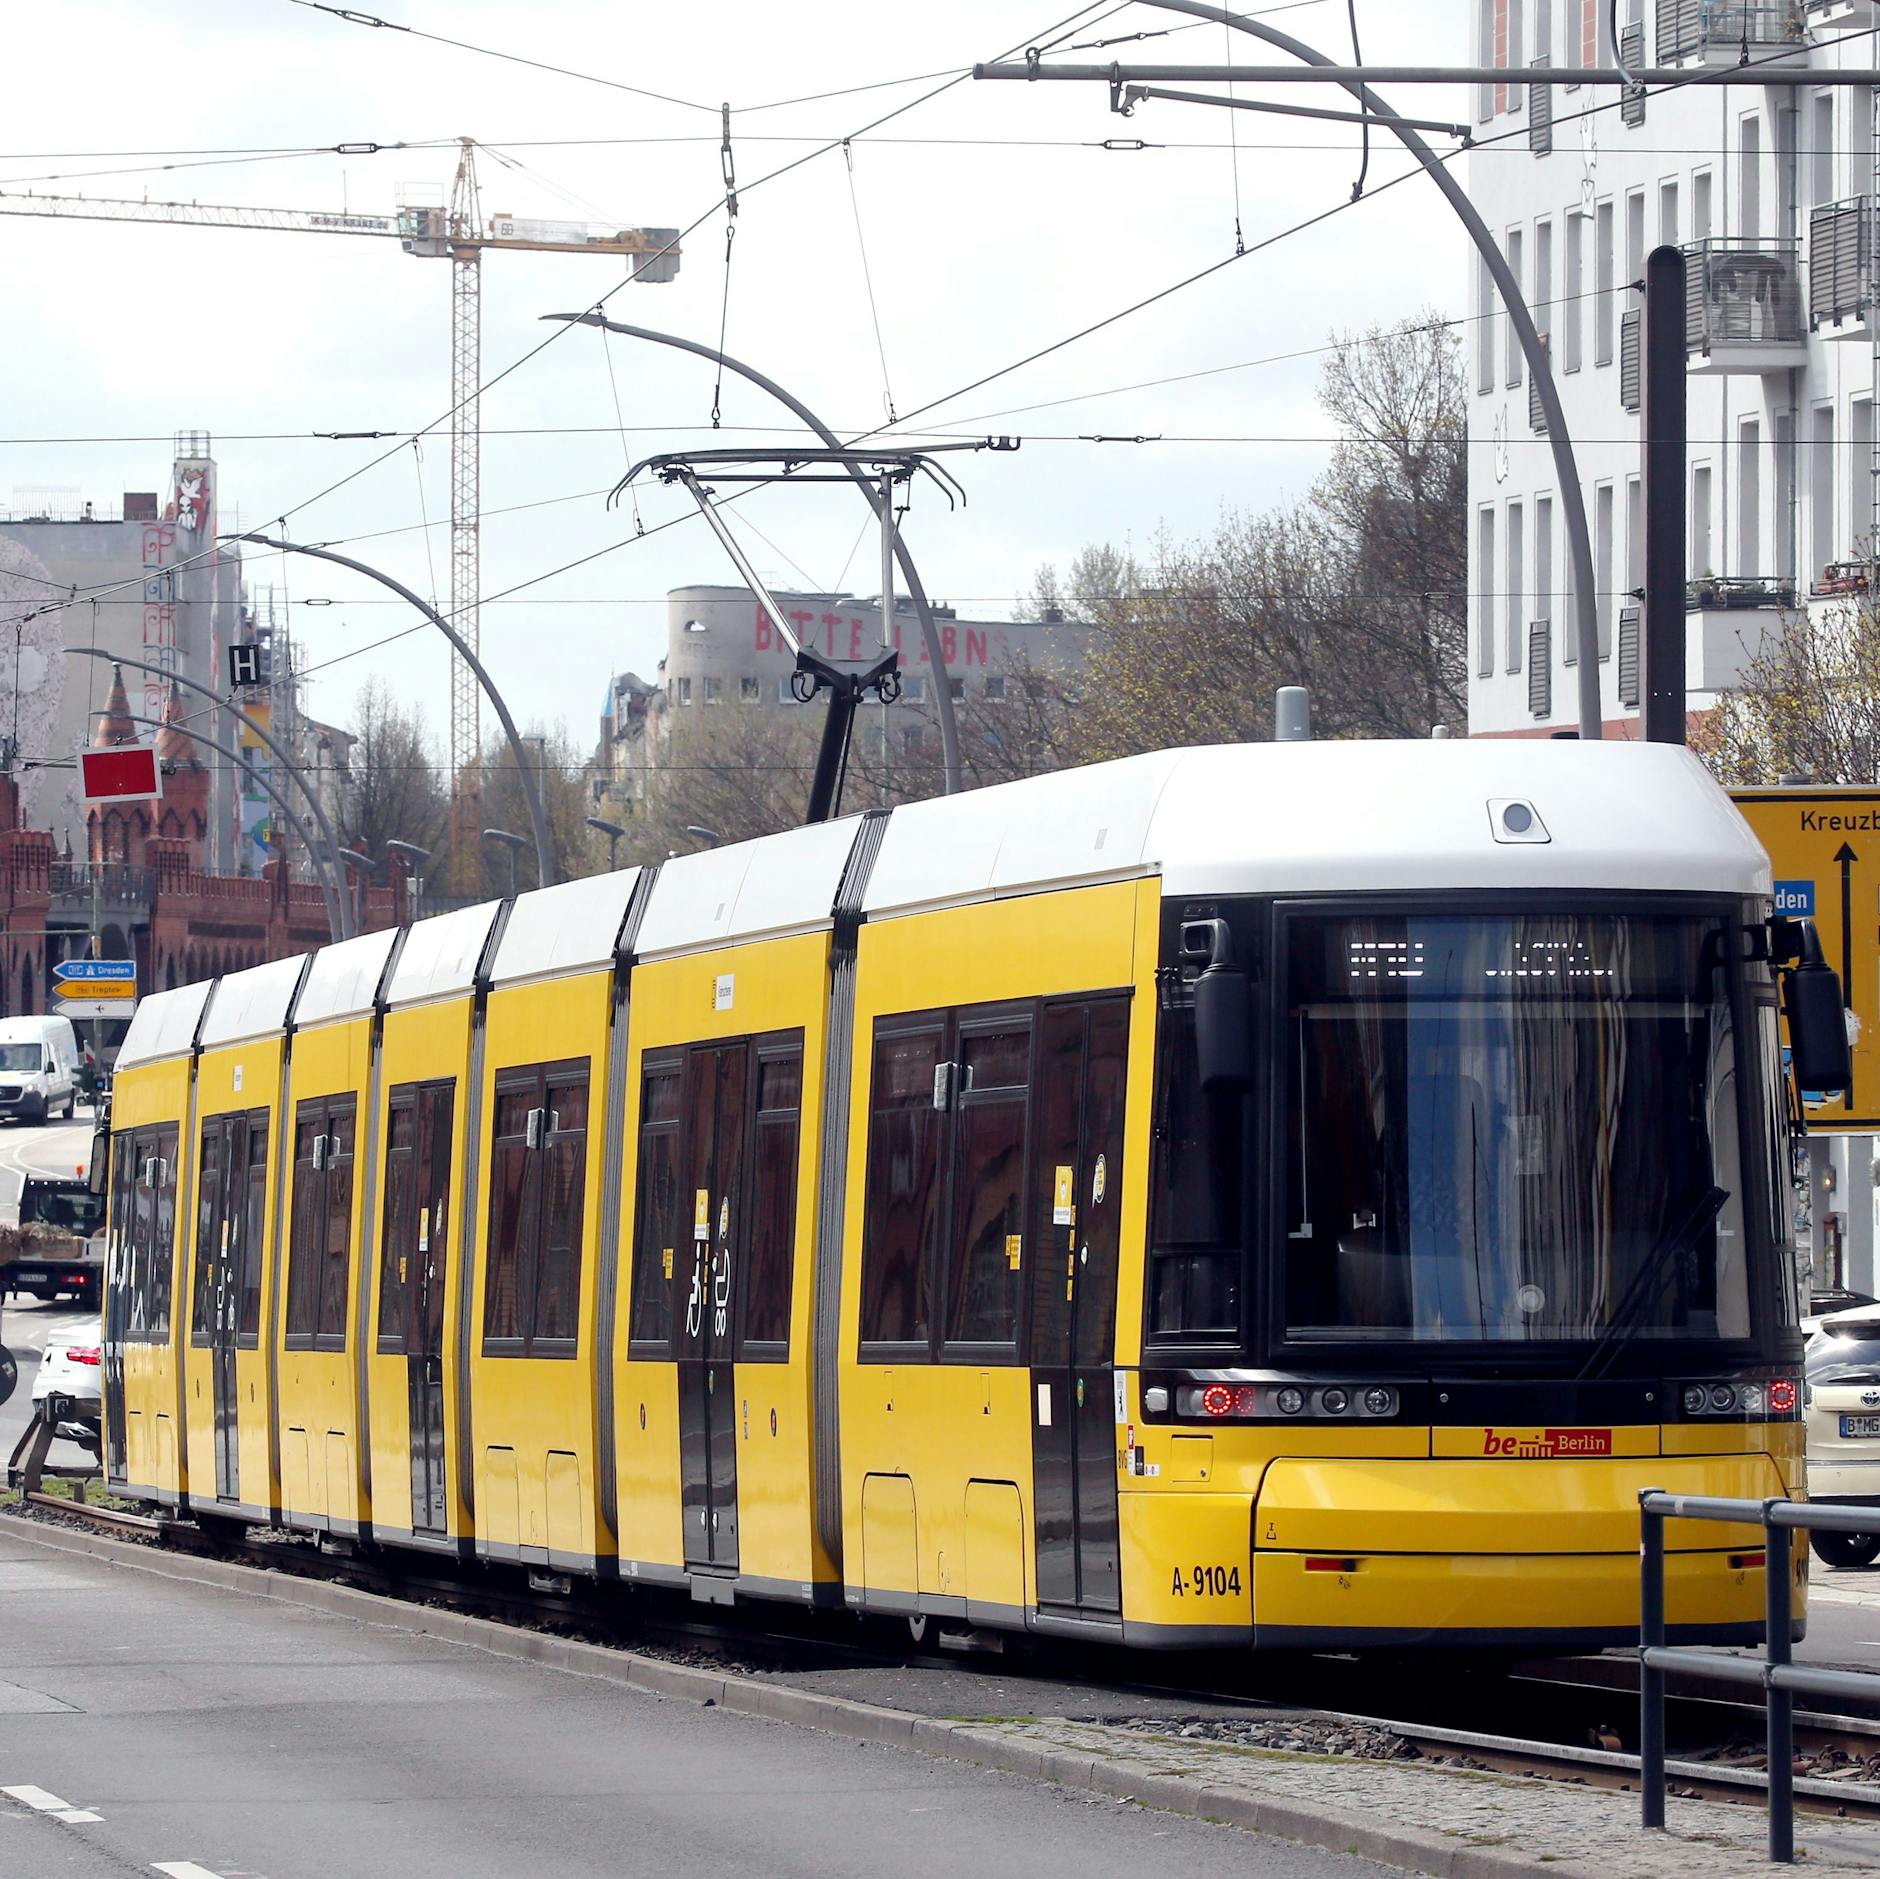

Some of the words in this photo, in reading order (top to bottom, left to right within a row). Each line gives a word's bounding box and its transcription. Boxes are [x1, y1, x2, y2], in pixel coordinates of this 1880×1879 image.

[754, 602, 863, 659] BITTE
[234, 649, 256, 681] H
[1801, 810, 1880, 831] Kreuzb
[97, 966, 130, 975] Dresden
[1847, 1418, 1855, 1432] B
[1863, 1417, 1879, 1432] MG
[1483, 1428, 1517, 1455] be
[1557, 1434, 1605, 1450] Berlin
[1172, 1565, 1241, 1597] A-9104
